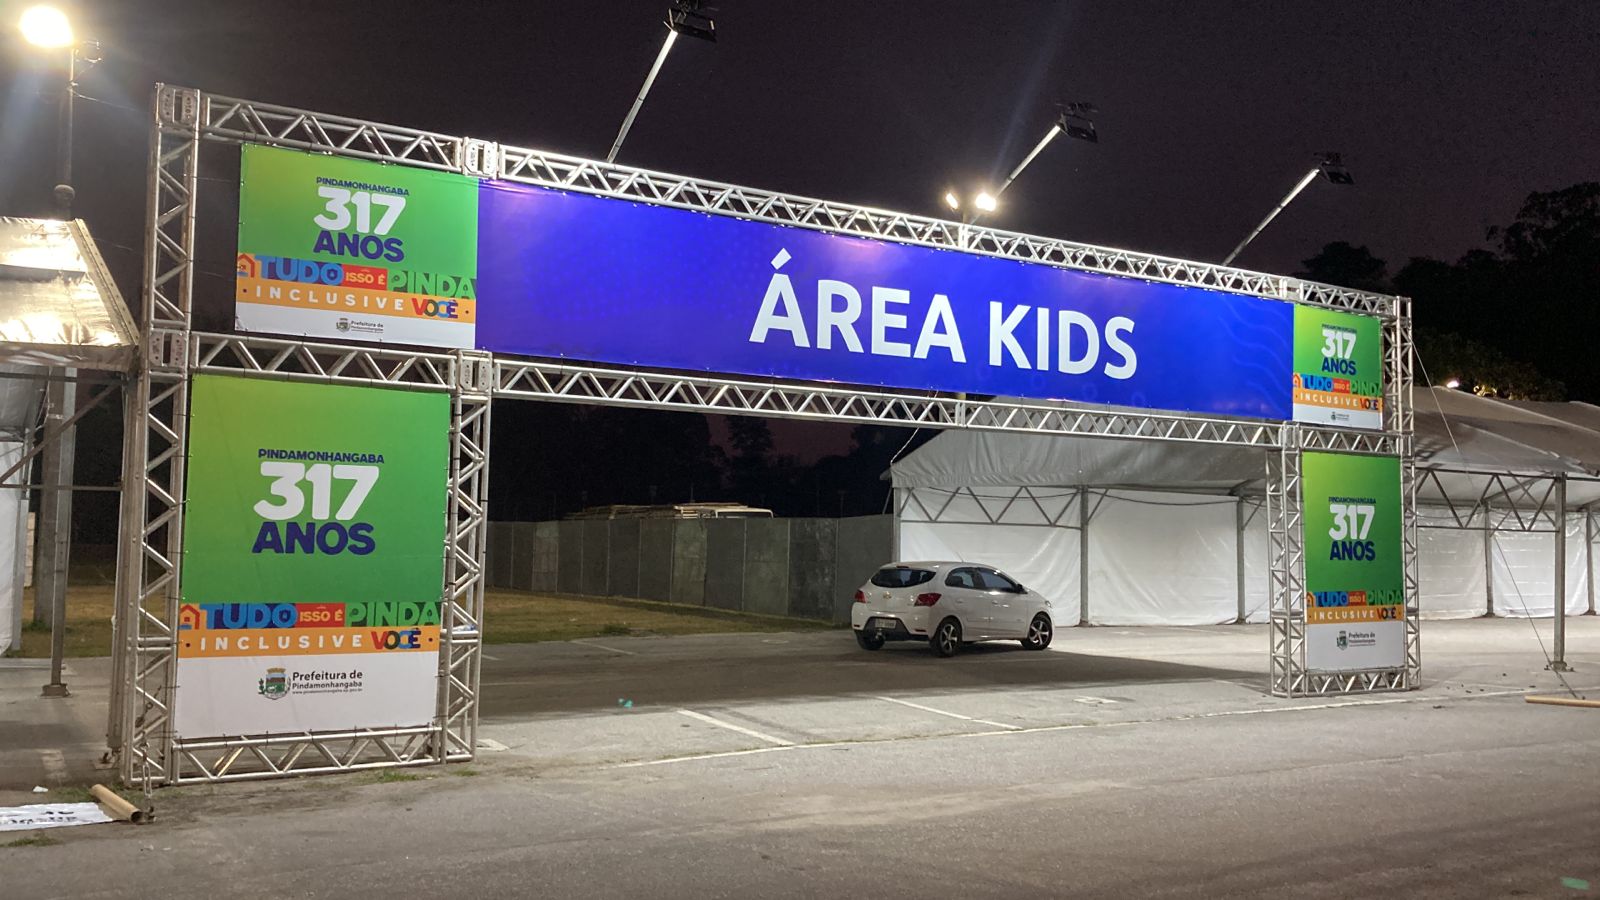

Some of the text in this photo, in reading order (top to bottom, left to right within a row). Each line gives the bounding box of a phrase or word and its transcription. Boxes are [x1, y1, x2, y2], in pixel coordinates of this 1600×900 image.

[316, 176, 409, 196] PINDAMONHANGABA
[313, 186, 407, 236] 317
[313, 230, 405, 262] ANOS
[254, 255, 476, 299] TUDO ISSO É PINDA
[256, 285, 459, 318] INCLUSIVE VOCÊ
[748, 247, 1137, 379] ÁREA KIDS
[1321, 328, 1357, 359] 317
[1322, 357, 1357, 376] ANOS
[1301, 374, 1334, 392] TUDO
[1300, 392, 1358, 407] INCLUSIVE
[258, 449, 385, 464] PINDAMONHANGABA
[253, 461, 379, 521] 317
[1329, 504, 1375, 540] 317
[252, 521, 376, 555] ANOS
[1330, 540, 1376, 561] ANOS
[1315, 591, 1349, 607] TUDO
[200, 601, 440, 629] TUDO ISSO É PINDA
[1314, 610, 1374, 620] INCLUSIVE
[201, 627, 421, 650] INCLUSIVE VOCÊ
[292, 680, 362, 690] Pindamonhangaba
[293, 669, 363, 681] Prefeitura de
